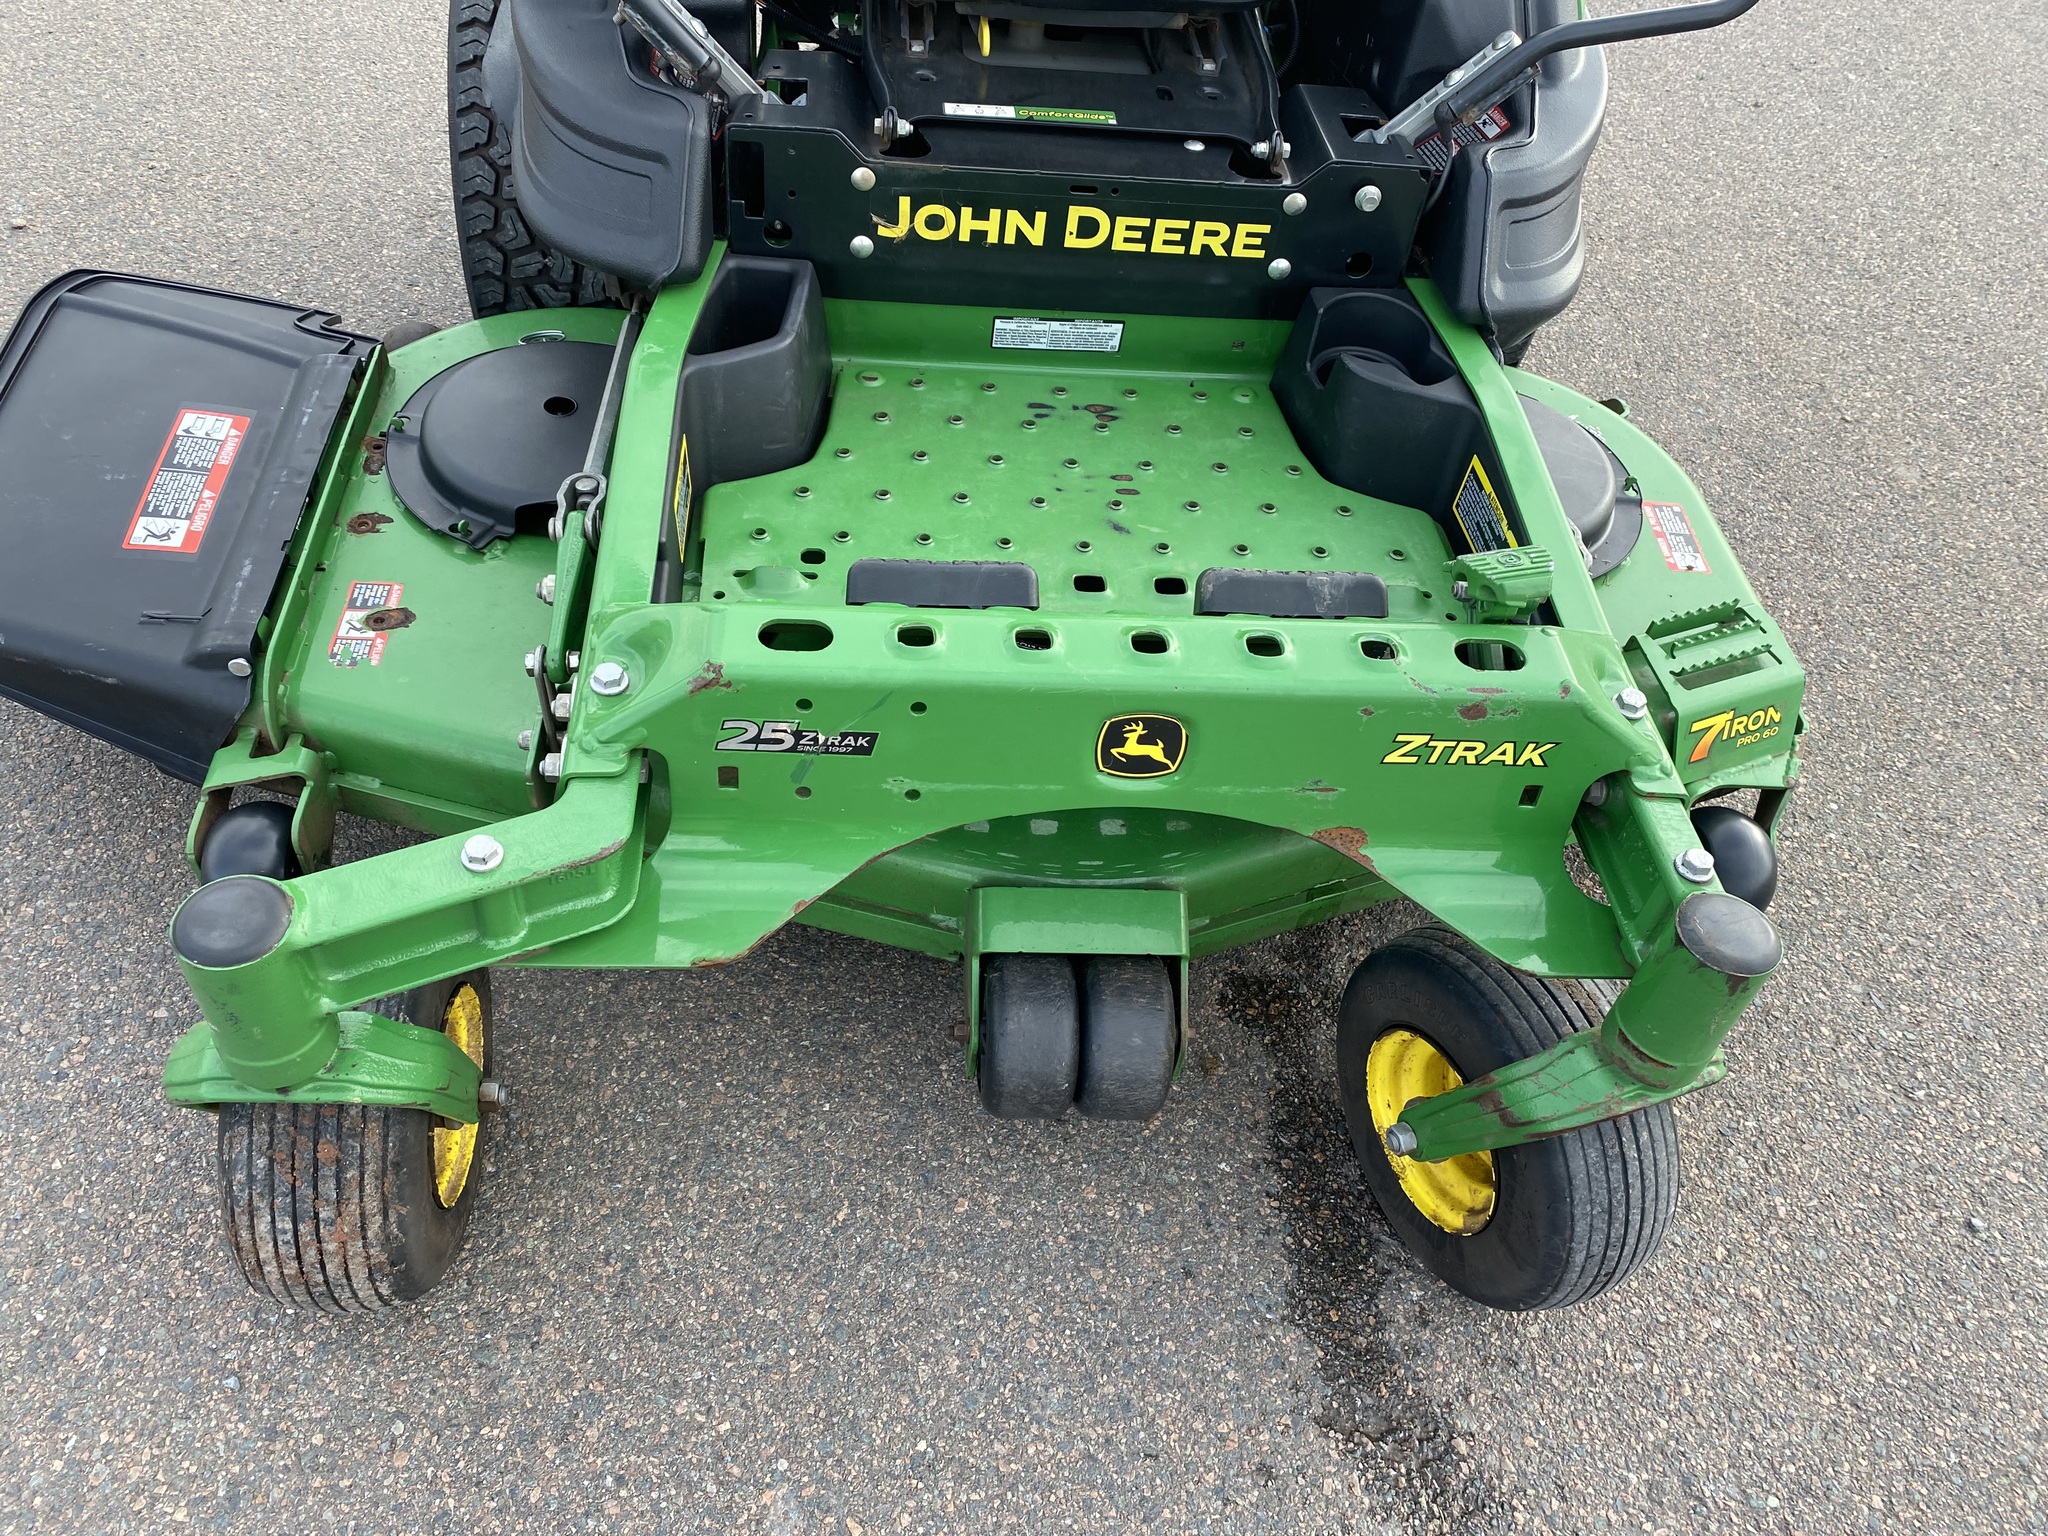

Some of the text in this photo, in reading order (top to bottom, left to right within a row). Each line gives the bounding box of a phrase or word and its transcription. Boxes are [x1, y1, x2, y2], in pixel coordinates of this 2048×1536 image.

[876, 195, 1272, 259] JOHN DEERE
[217, 437, 239, 466] DANGER
[190, 499, 214, 532] PELIGRO
[716, 720, 799, 751] 25
[1381, 734, 1560, 767] ZTRAK
[1736, 726, 1779, 749] PRO 60
